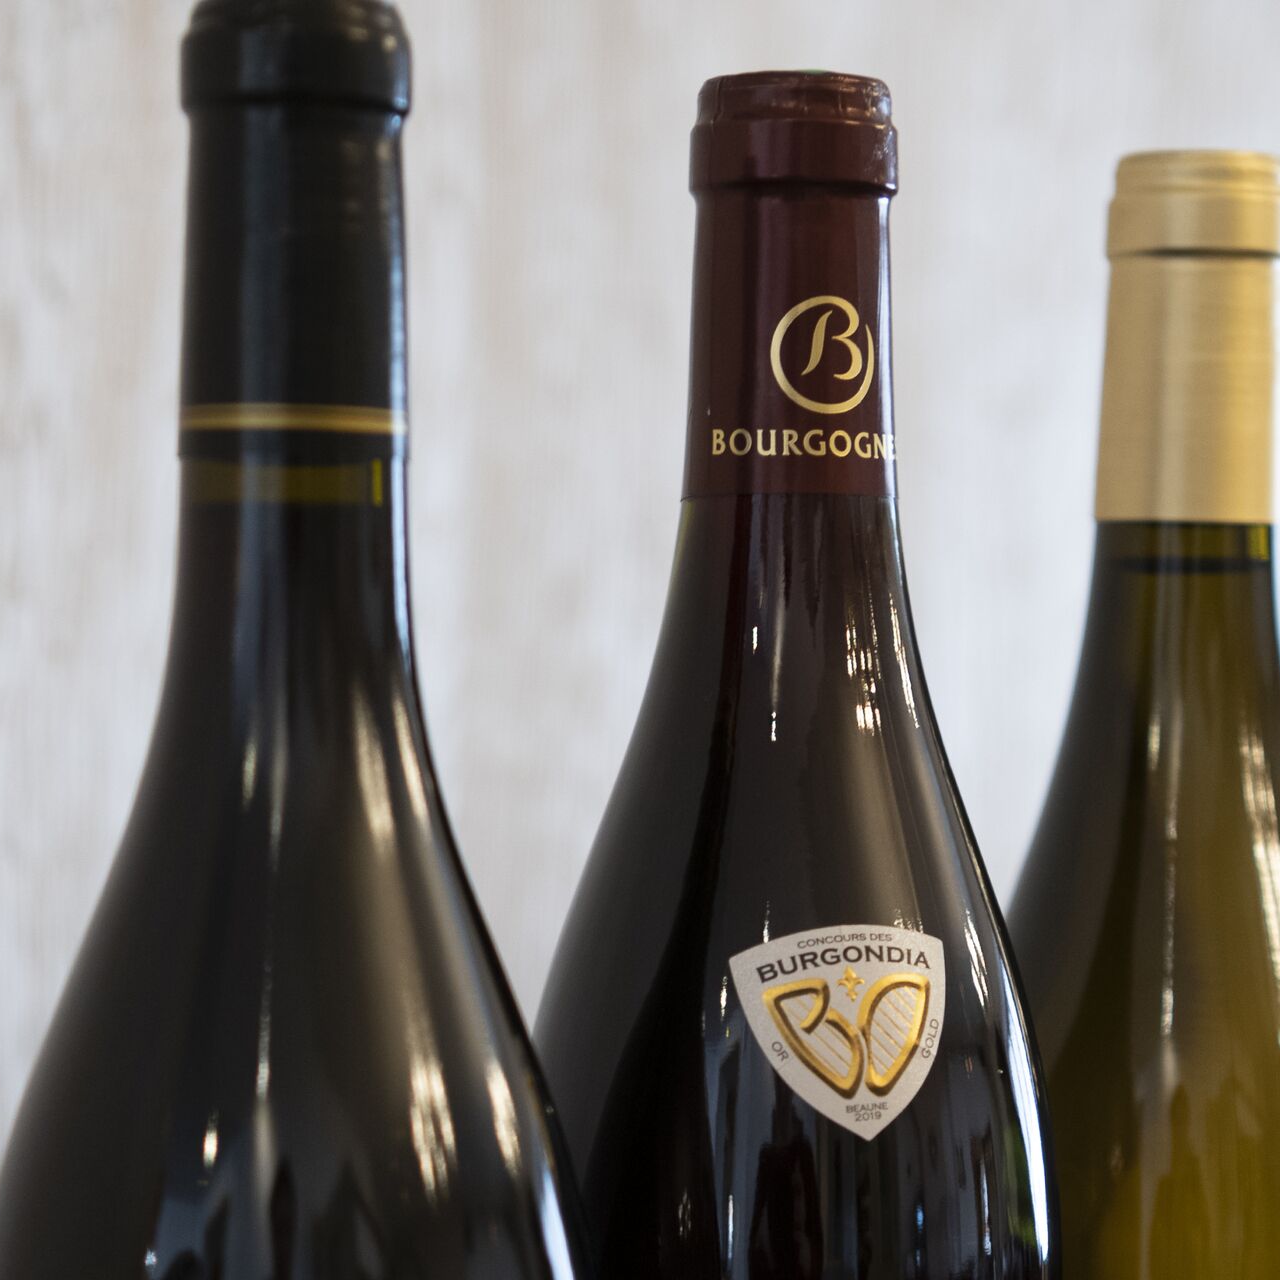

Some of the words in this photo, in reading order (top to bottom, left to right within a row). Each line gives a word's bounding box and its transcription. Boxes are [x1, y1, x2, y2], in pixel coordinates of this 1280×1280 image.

[712, 428, 895, 460] BOURGOGNE
[797, 933, 867, 949] CONCOURS
[870, 933, 893, 942] DES
[756, 945, 931, 984] BURGONDIA
[921, 1018, 939, 1059] GOLD
[772, 1040, 789, 1062] OR
[846, 1102, 888, 1114] BEAUNE
[855, 1111, 882, 1122] 2019
